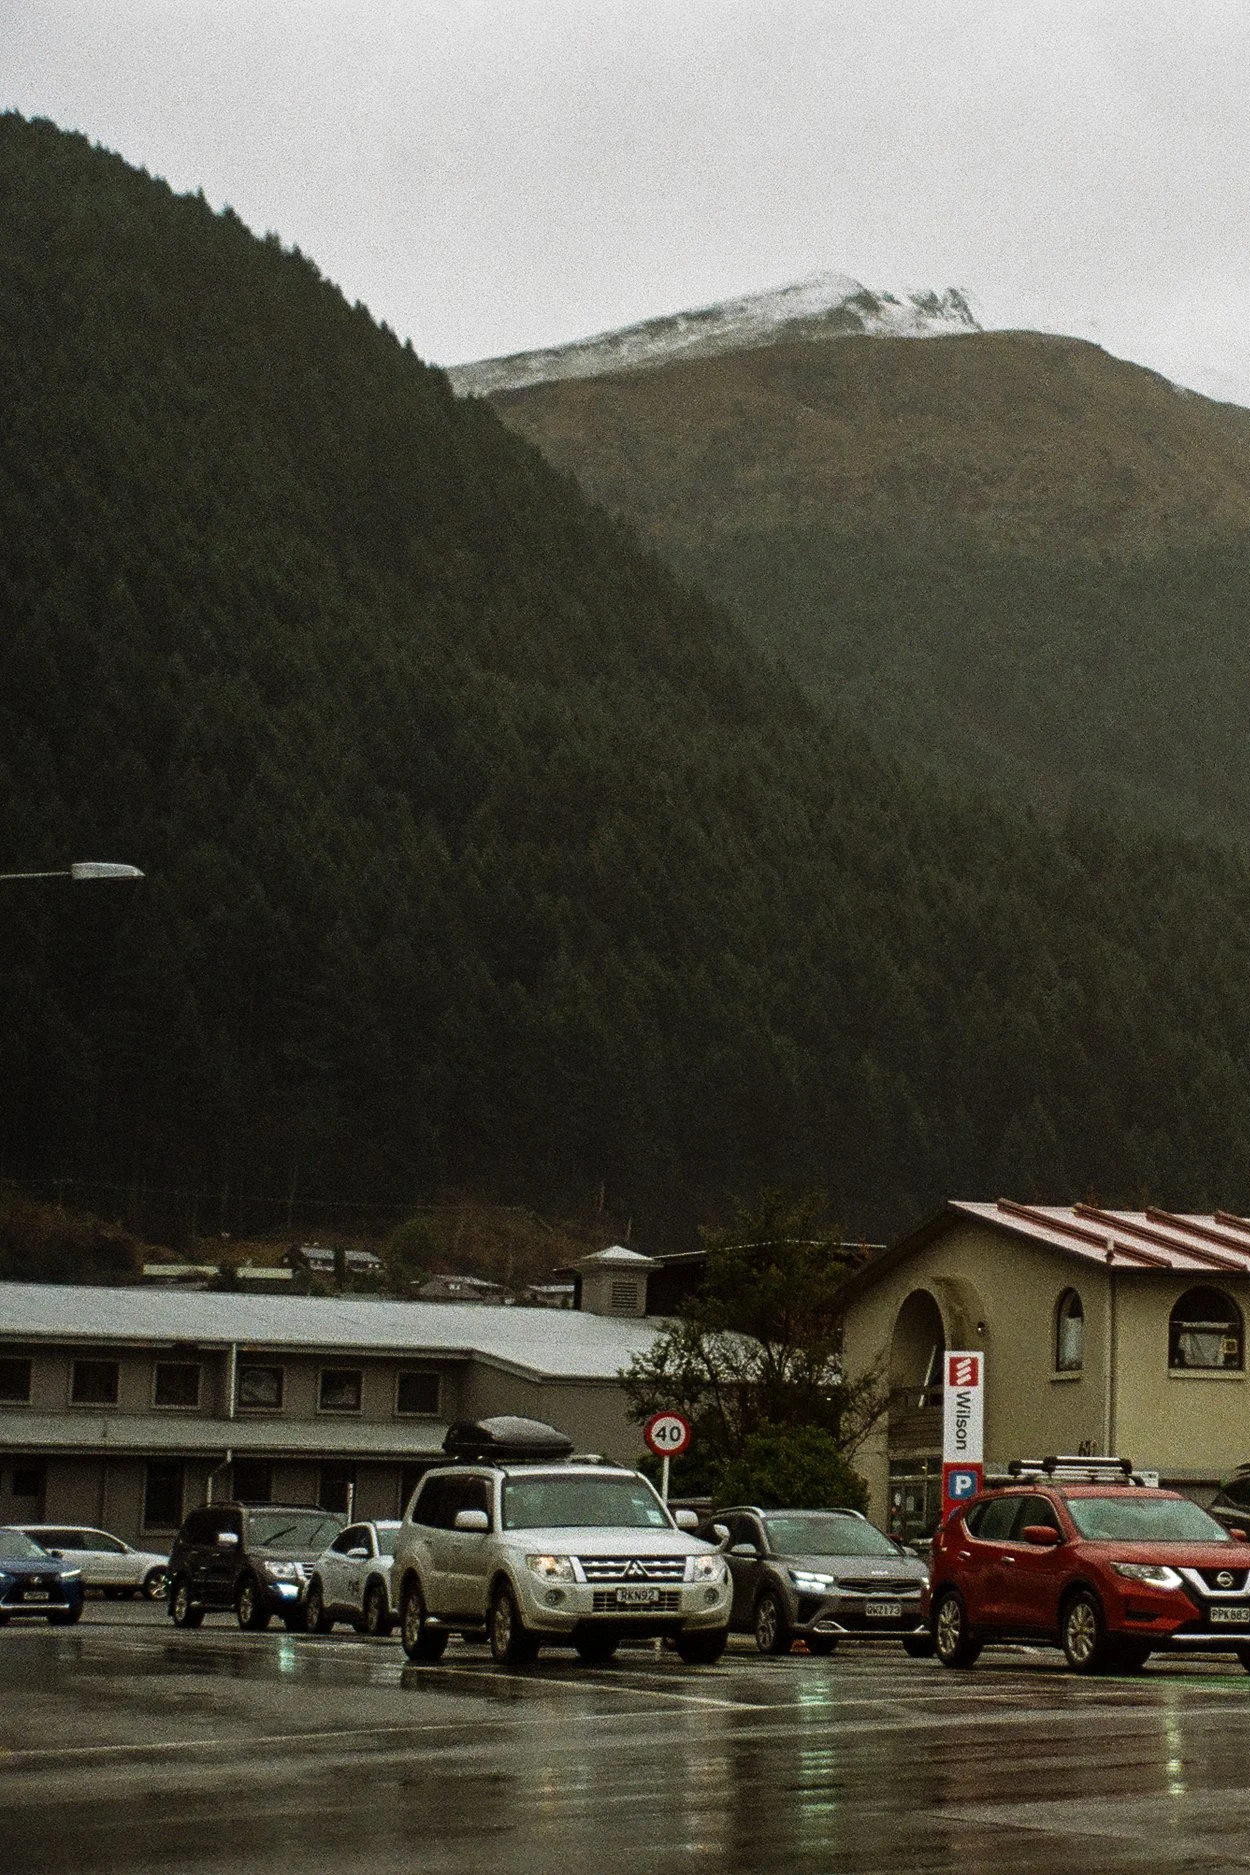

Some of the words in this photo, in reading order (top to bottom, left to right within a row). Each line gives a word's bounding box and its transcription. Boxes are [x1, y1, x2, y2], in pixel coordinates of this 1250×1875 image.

[956, 1391, 971, 1450] Wilson
[655, 1426, 681, 1442] 40
[955, 1475, 972, 1495] P
[620, 1590, 655, 1601] RKN92
